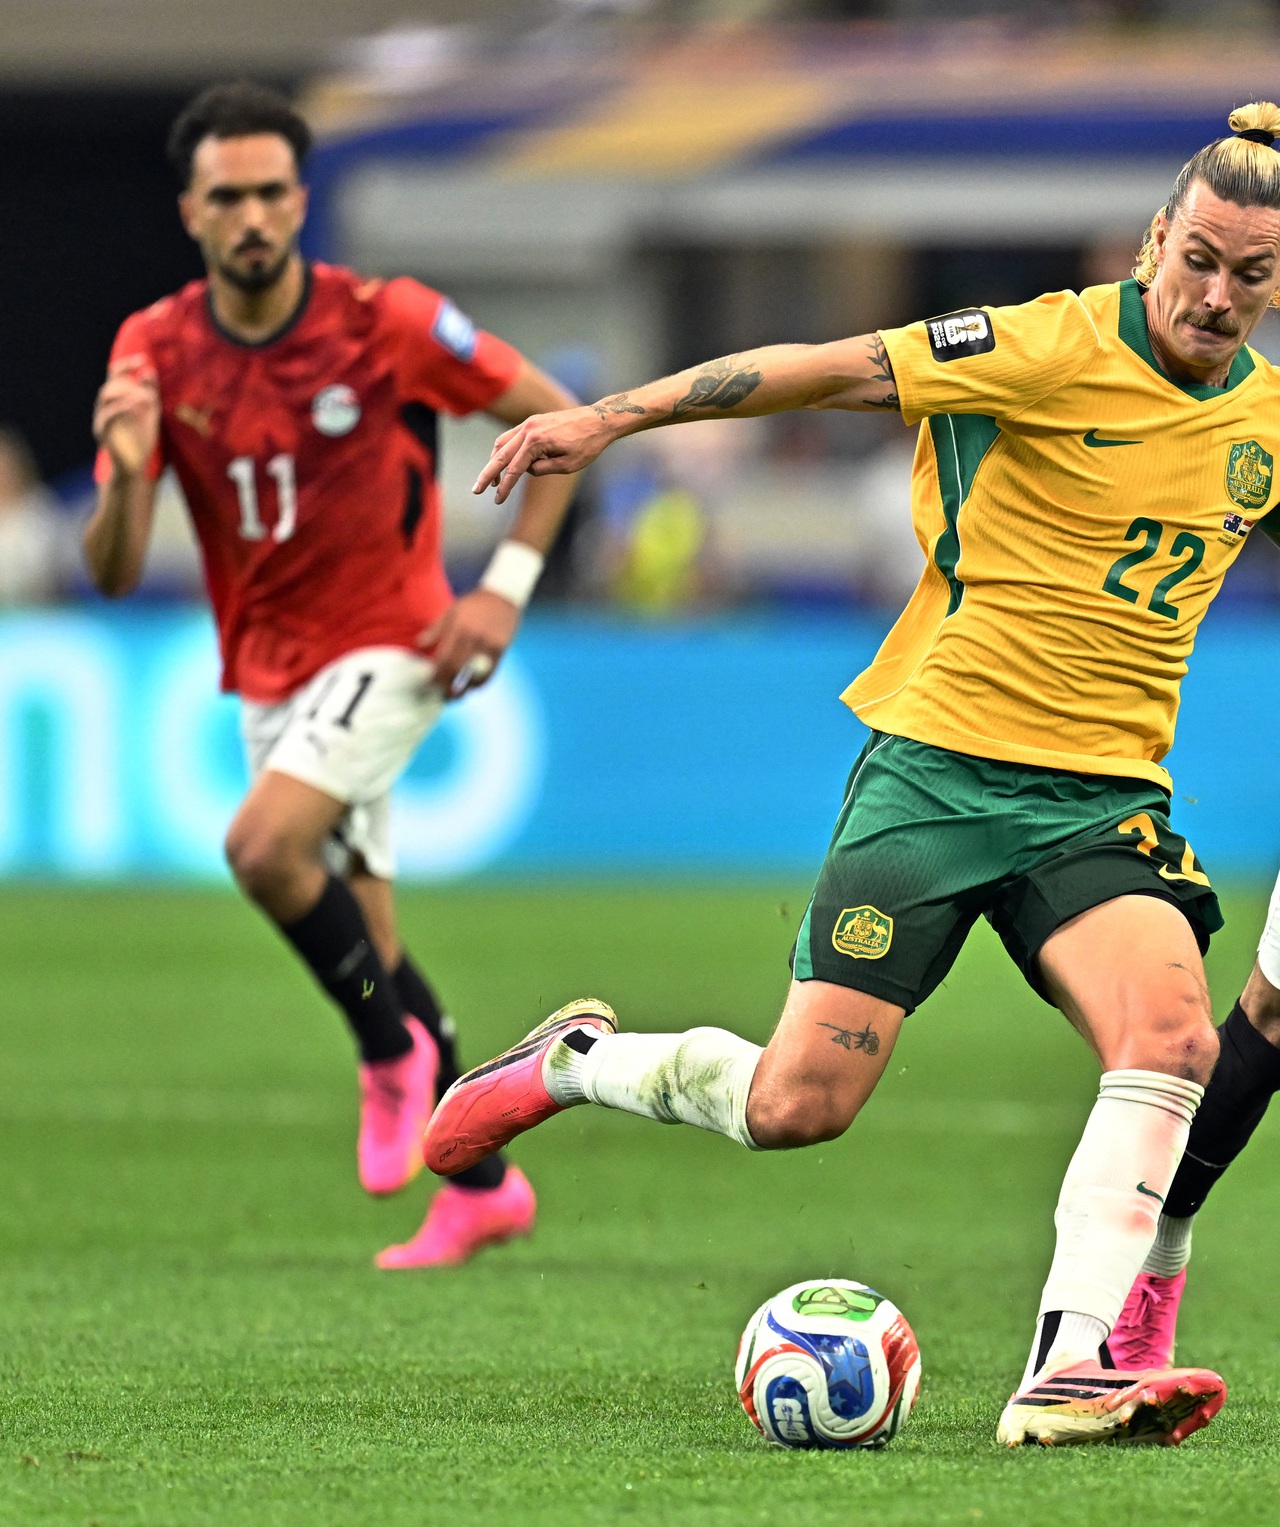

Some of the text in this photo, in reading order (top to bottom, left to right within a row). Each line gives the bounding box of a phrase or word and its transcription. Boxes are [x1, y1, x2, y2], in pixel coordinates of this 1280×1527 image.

[930, 323, 942, 348] 2026
[226, 454, 298, 544] 11
[1233, 480, 1263, 495] AUSTRALIA
[1101, 516, 1206, 621] 22
[842, 936, 878, 947] AUSTRALIA
